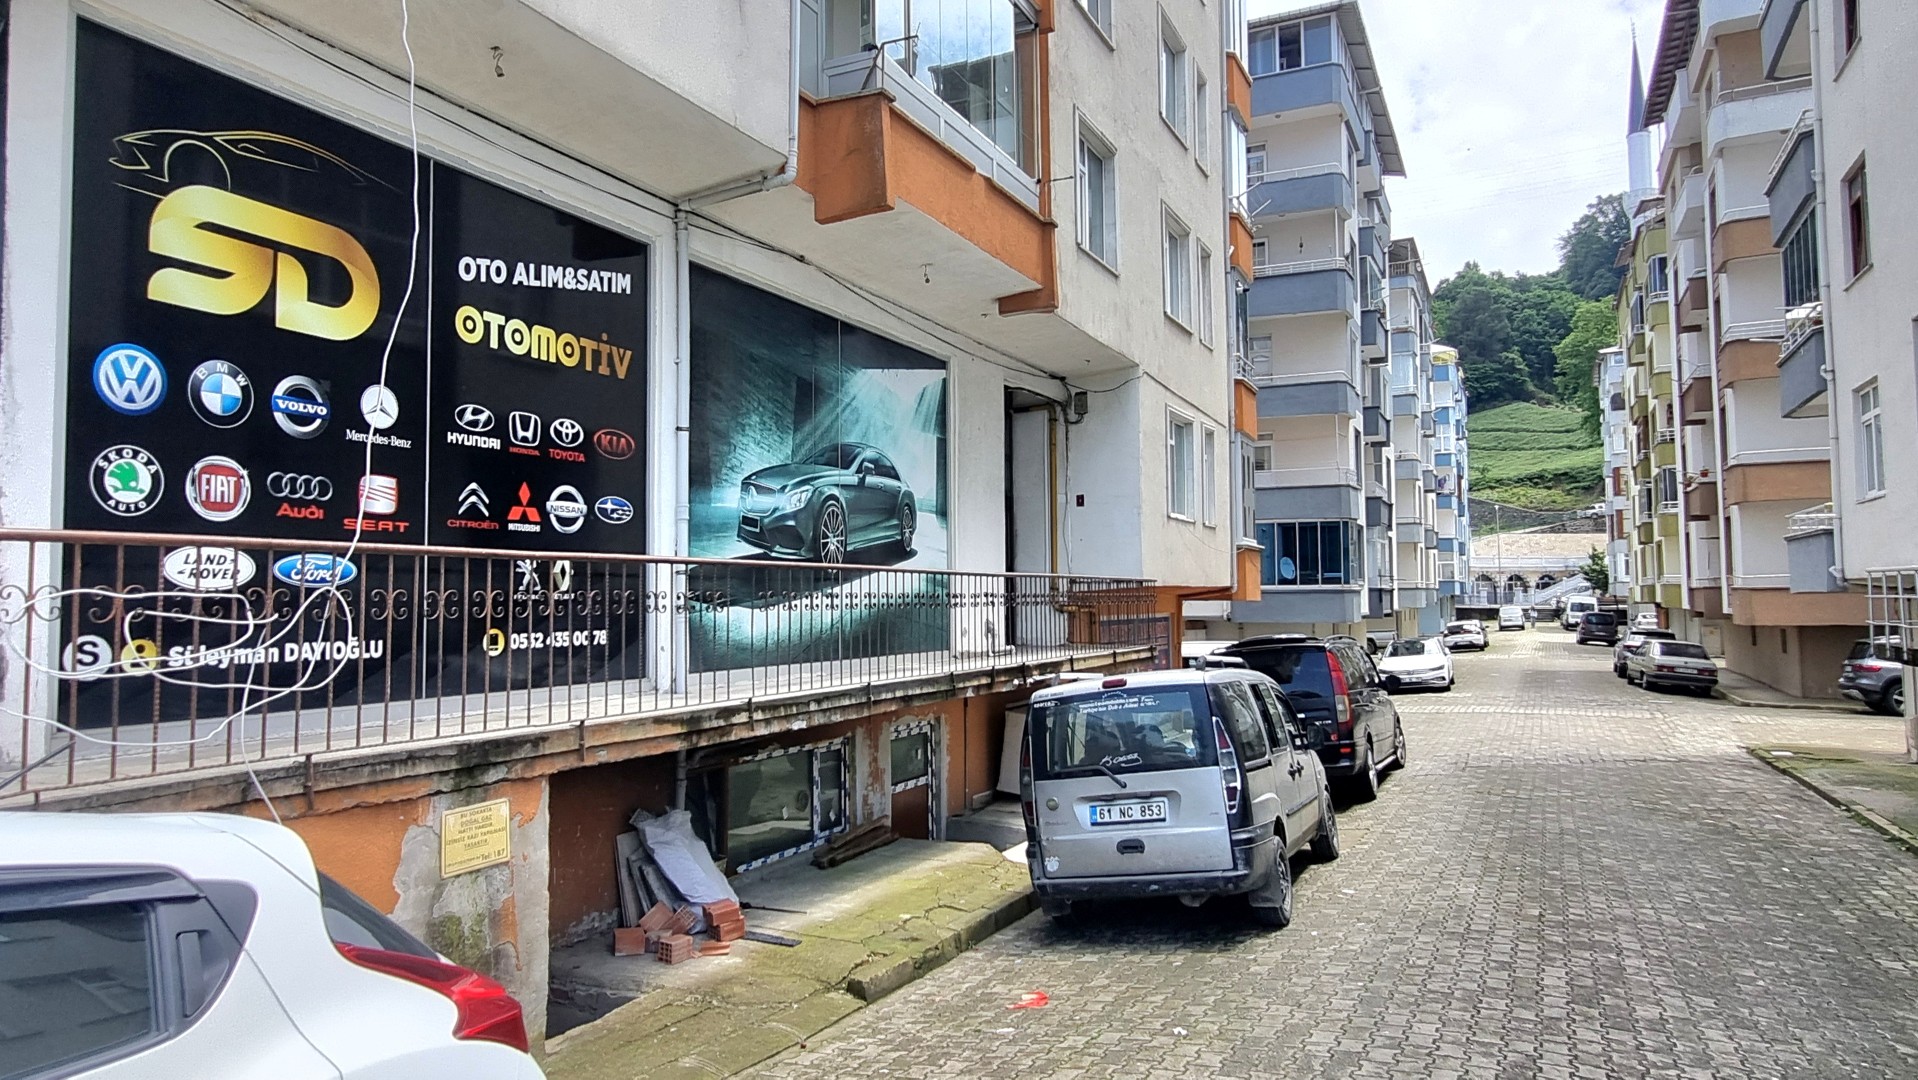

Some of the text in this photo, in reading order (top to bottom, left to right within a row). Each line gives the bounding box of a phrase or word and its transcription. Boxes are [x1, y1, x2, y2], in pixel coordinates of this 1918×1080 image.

[147, 184, 381, 341] SD
[458, 256, 632, 295] OTO ALIM&SATIM
[455, 305, 633, 380] OTOMOTİV
[195, 362, 248, 387] BMW
[275, 399, 328, 416] VOLVO
[345, 429, 412, 449] Mercedes-Benz
[447, 431, 501, 450] HYUNDAI
[600, 434, 629, 454] KIA
[509, 446, 540, 456] HONDA
[548, 448, 586, 462] TOYOTA
[98, 448, 158, 474] SKODA
[201, 474, 238, 504] FIAT
[106, 499, 147, 511] AUTO
[275, 503, 326, 519] Audi
[550, 504, 584, 515] NISSAN
[343, 518, 410, 532] SEAT
[508, 522, 541, 533] MITSUBISHI
[183, 553, 228, 566] LAND
[188, 568, 241, 581] ROVER
[290, 557, 341, 582] Ford
[592, 629, 608, 645] 78
[284, 636, 383, 662] DAYIOĞLU
[469, 807, 493, 817] SOKAKTA
[481, 814, 493, 823] GAZ
[1099, 804, 1162, 820] 61 NC 853
[493, 847, 505, 858] 187
